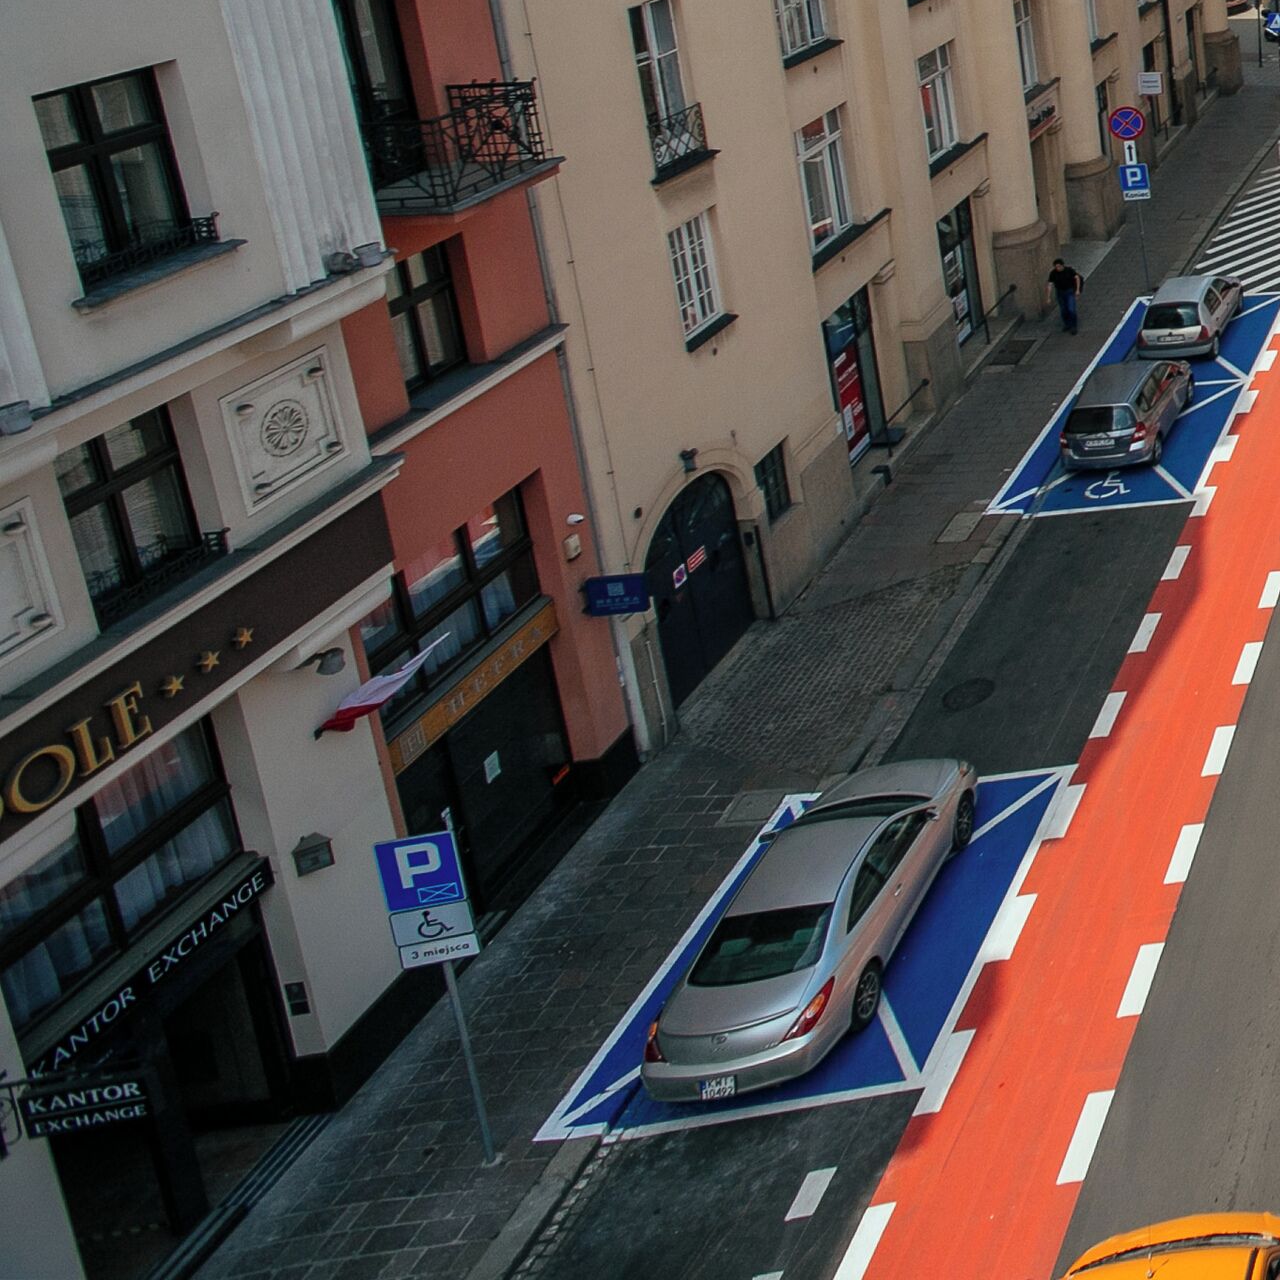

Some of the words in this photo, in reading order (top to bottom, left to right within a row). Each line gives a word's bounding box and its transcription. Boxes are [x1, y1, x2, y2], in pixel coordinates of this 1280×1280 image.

[0, 680, 153, 821] OLE
[394, 841, 442, 889] P
[411, 950, 420, 960] 3
[423, 942, 470, 957] miejsca
[31, 986, 136, 1079] KANTOR
[148, 871, 266, 984] EXCHANGE
[28, 1082, 141, 1114] KANTOR
[35, 1104, 148, 1135] EXCHANGE
